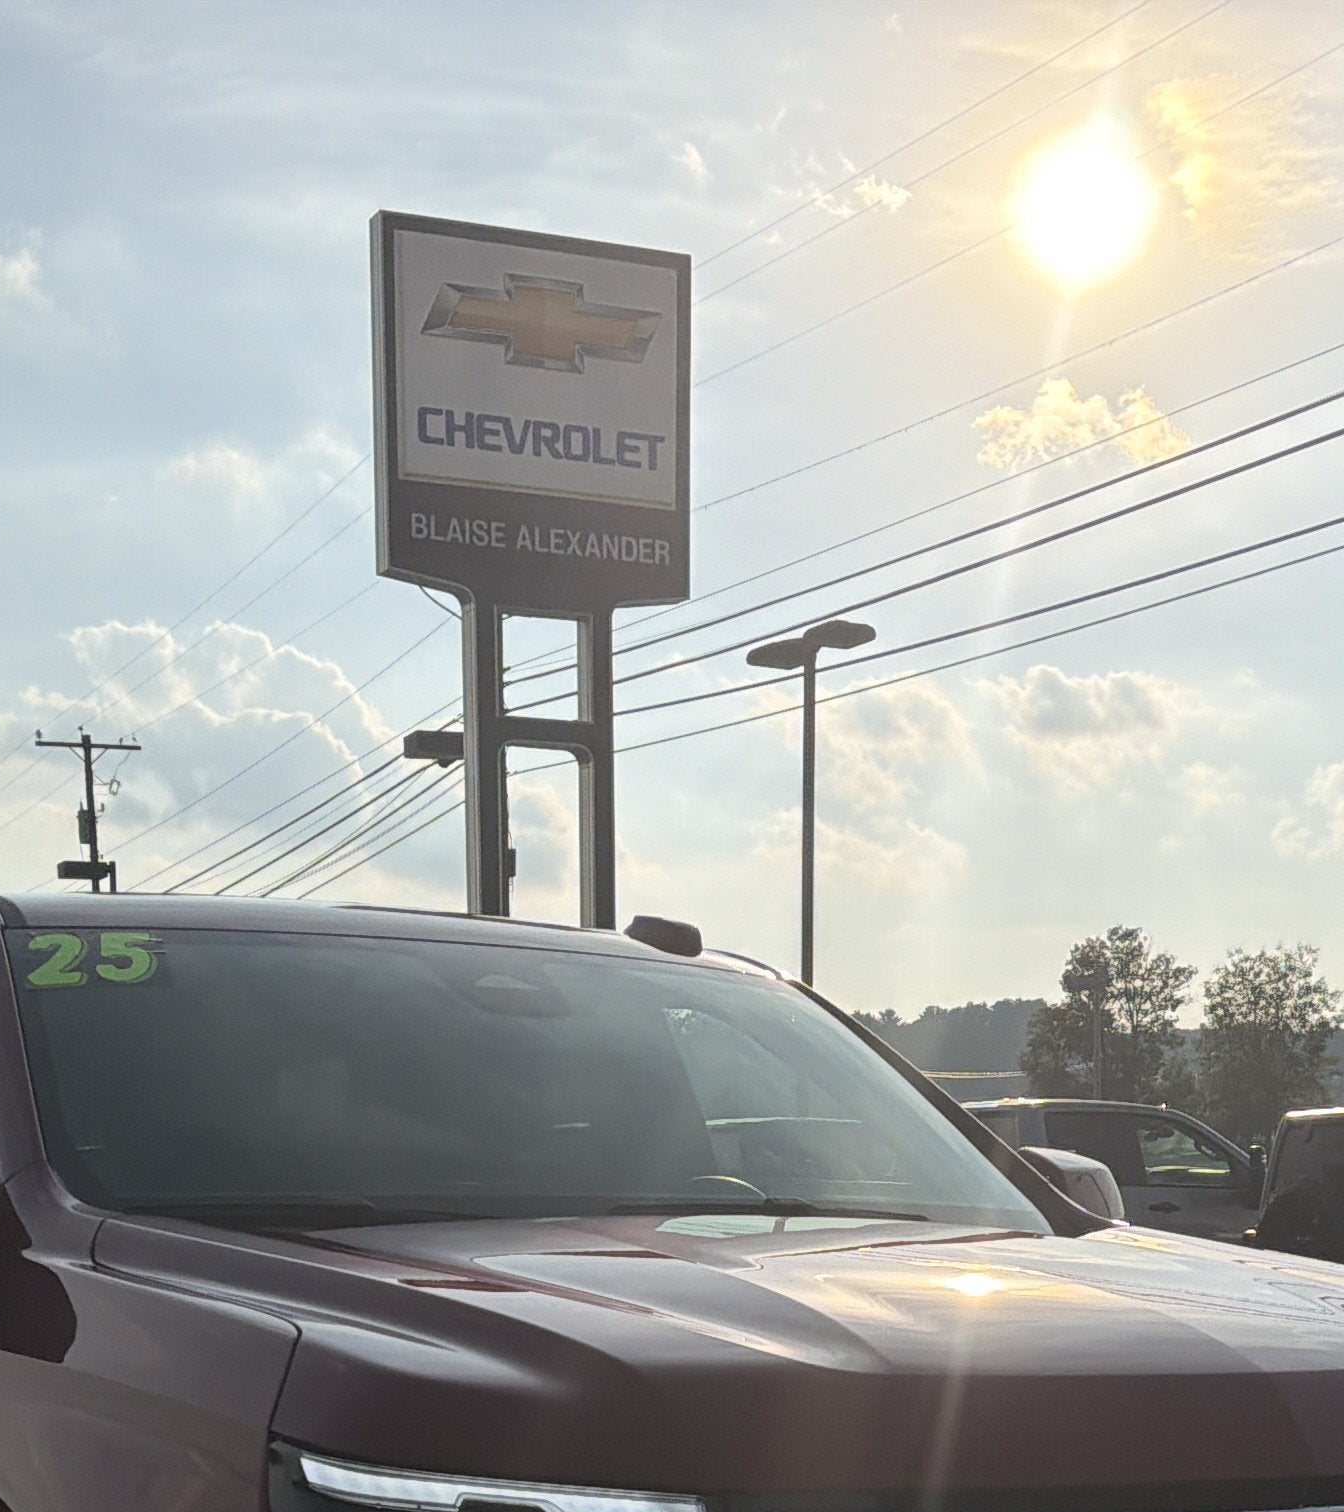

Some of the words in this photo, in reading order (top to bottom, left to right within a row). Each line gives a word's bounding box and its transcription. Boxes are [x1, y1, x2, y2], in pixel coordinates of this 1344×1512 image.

[417, 406, 666, 470] CHEVROLET
[411, 513, 506, 547] BLAISE
[516, 525, 670, 565] ALEXANDER
[27, 932, 158, 987] 25
